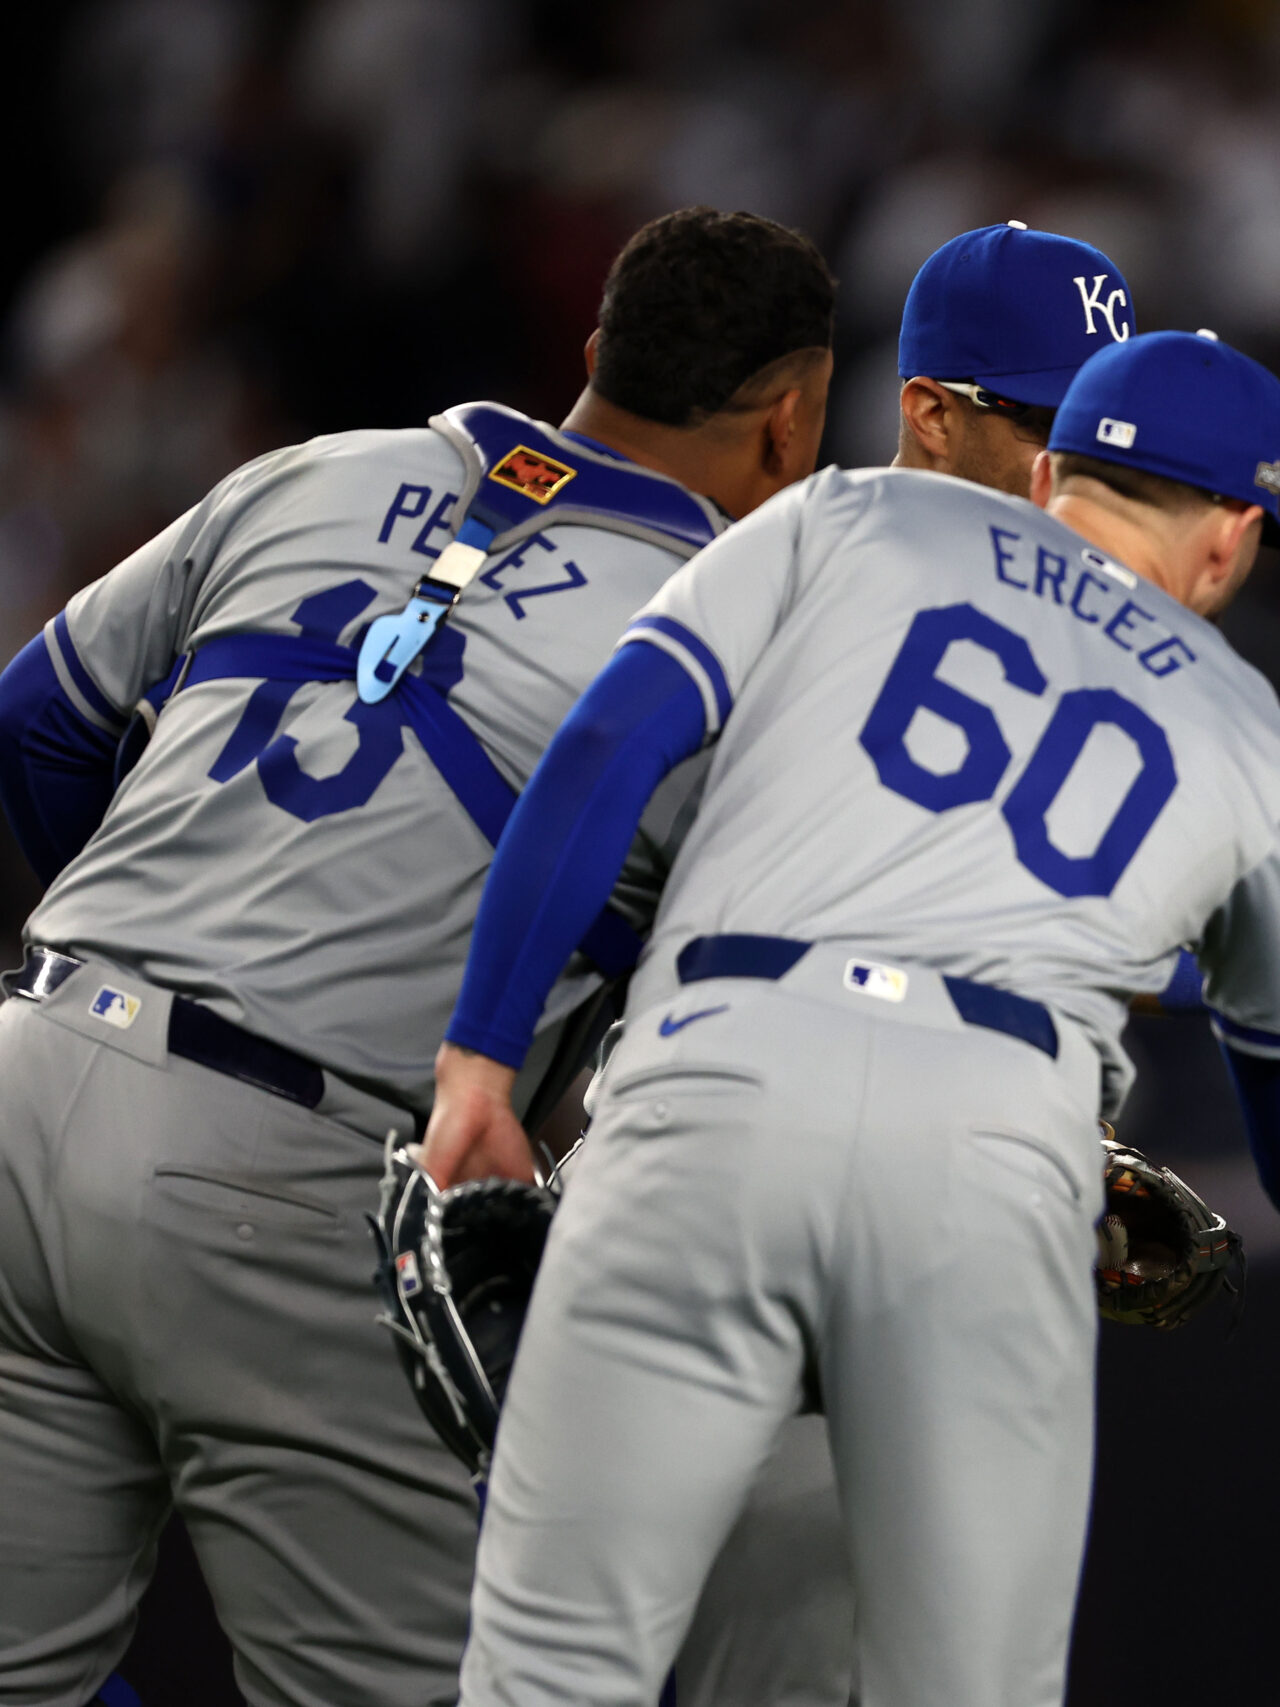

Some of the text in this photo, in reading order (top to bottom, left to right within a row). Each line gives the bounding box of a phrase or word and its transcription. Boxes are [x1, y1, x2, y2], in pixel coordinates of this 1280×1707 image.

[1073, 274, 1129, 343] KC
[377, 482, 588, 620] PEEZ
[988, 523, 1197, 678] ERCEG
[858, 601, 1179, 899] 60
